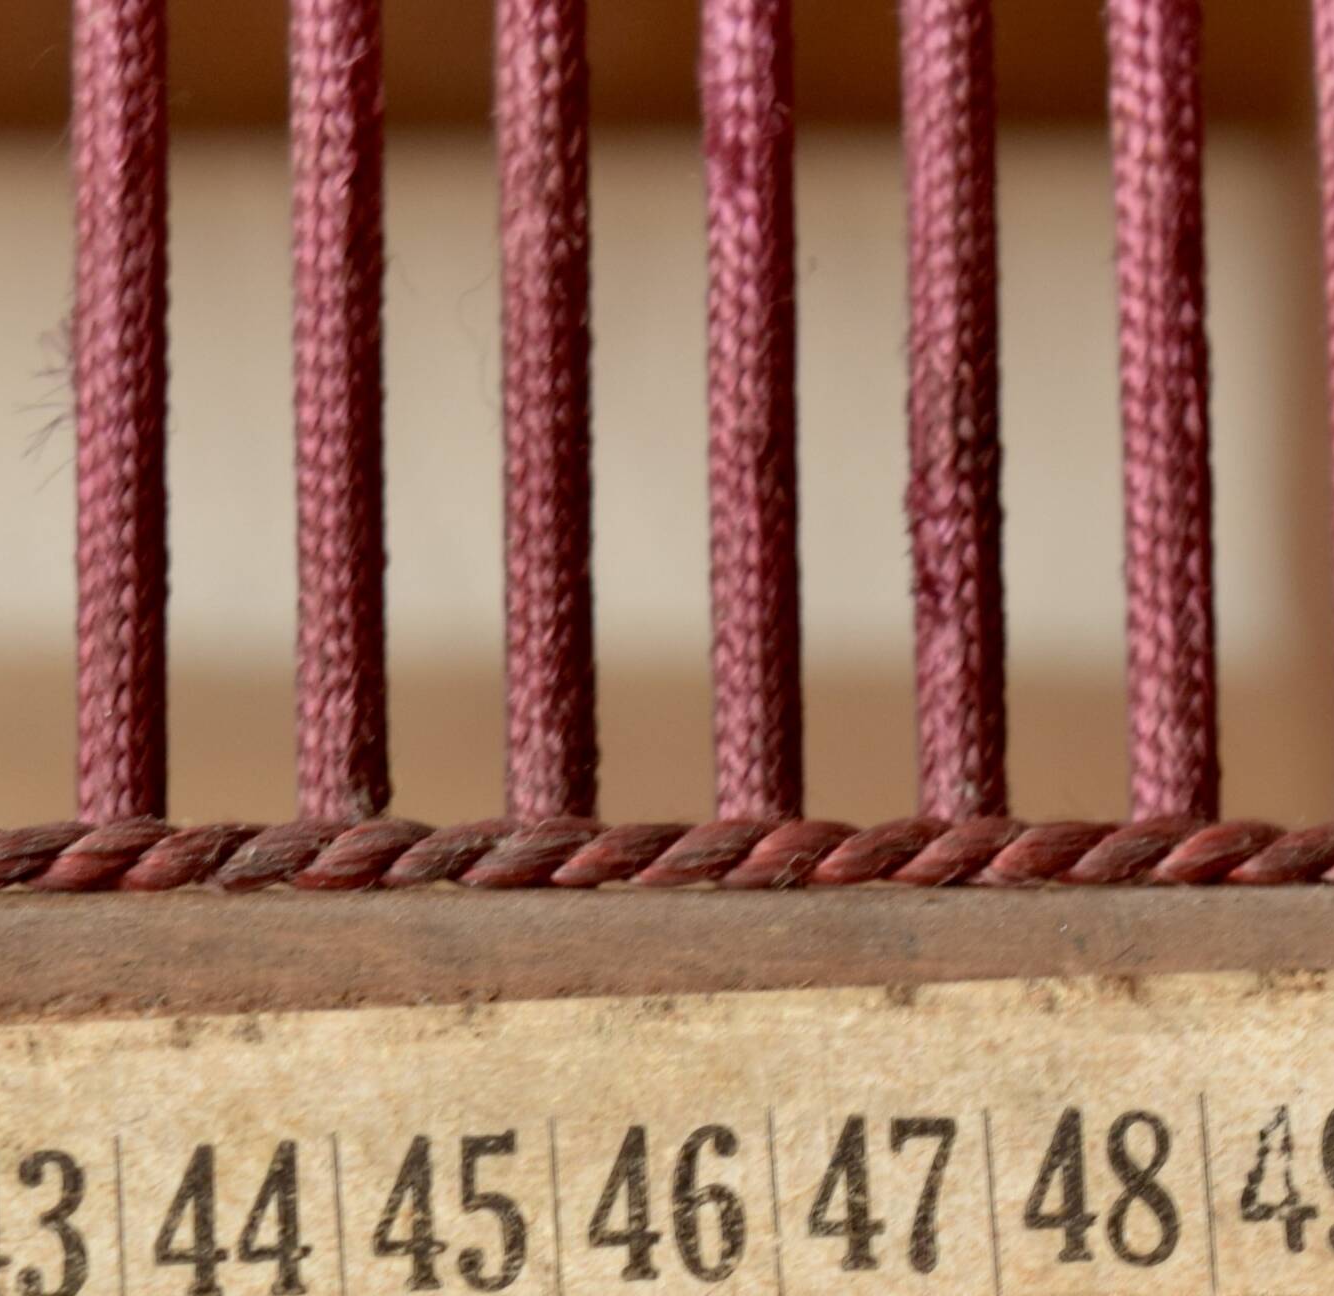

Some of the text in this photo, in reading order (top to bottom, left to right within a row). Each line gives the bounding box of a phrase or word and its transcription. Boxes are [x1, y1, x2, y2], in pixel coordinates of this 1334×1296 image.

[372, 1129, 527, 1292] 45
[588, 1123, 747, 1283] 46
[807, 1114, 955, 1274] 47
[1024, 1107, 1180, 1268] 48
